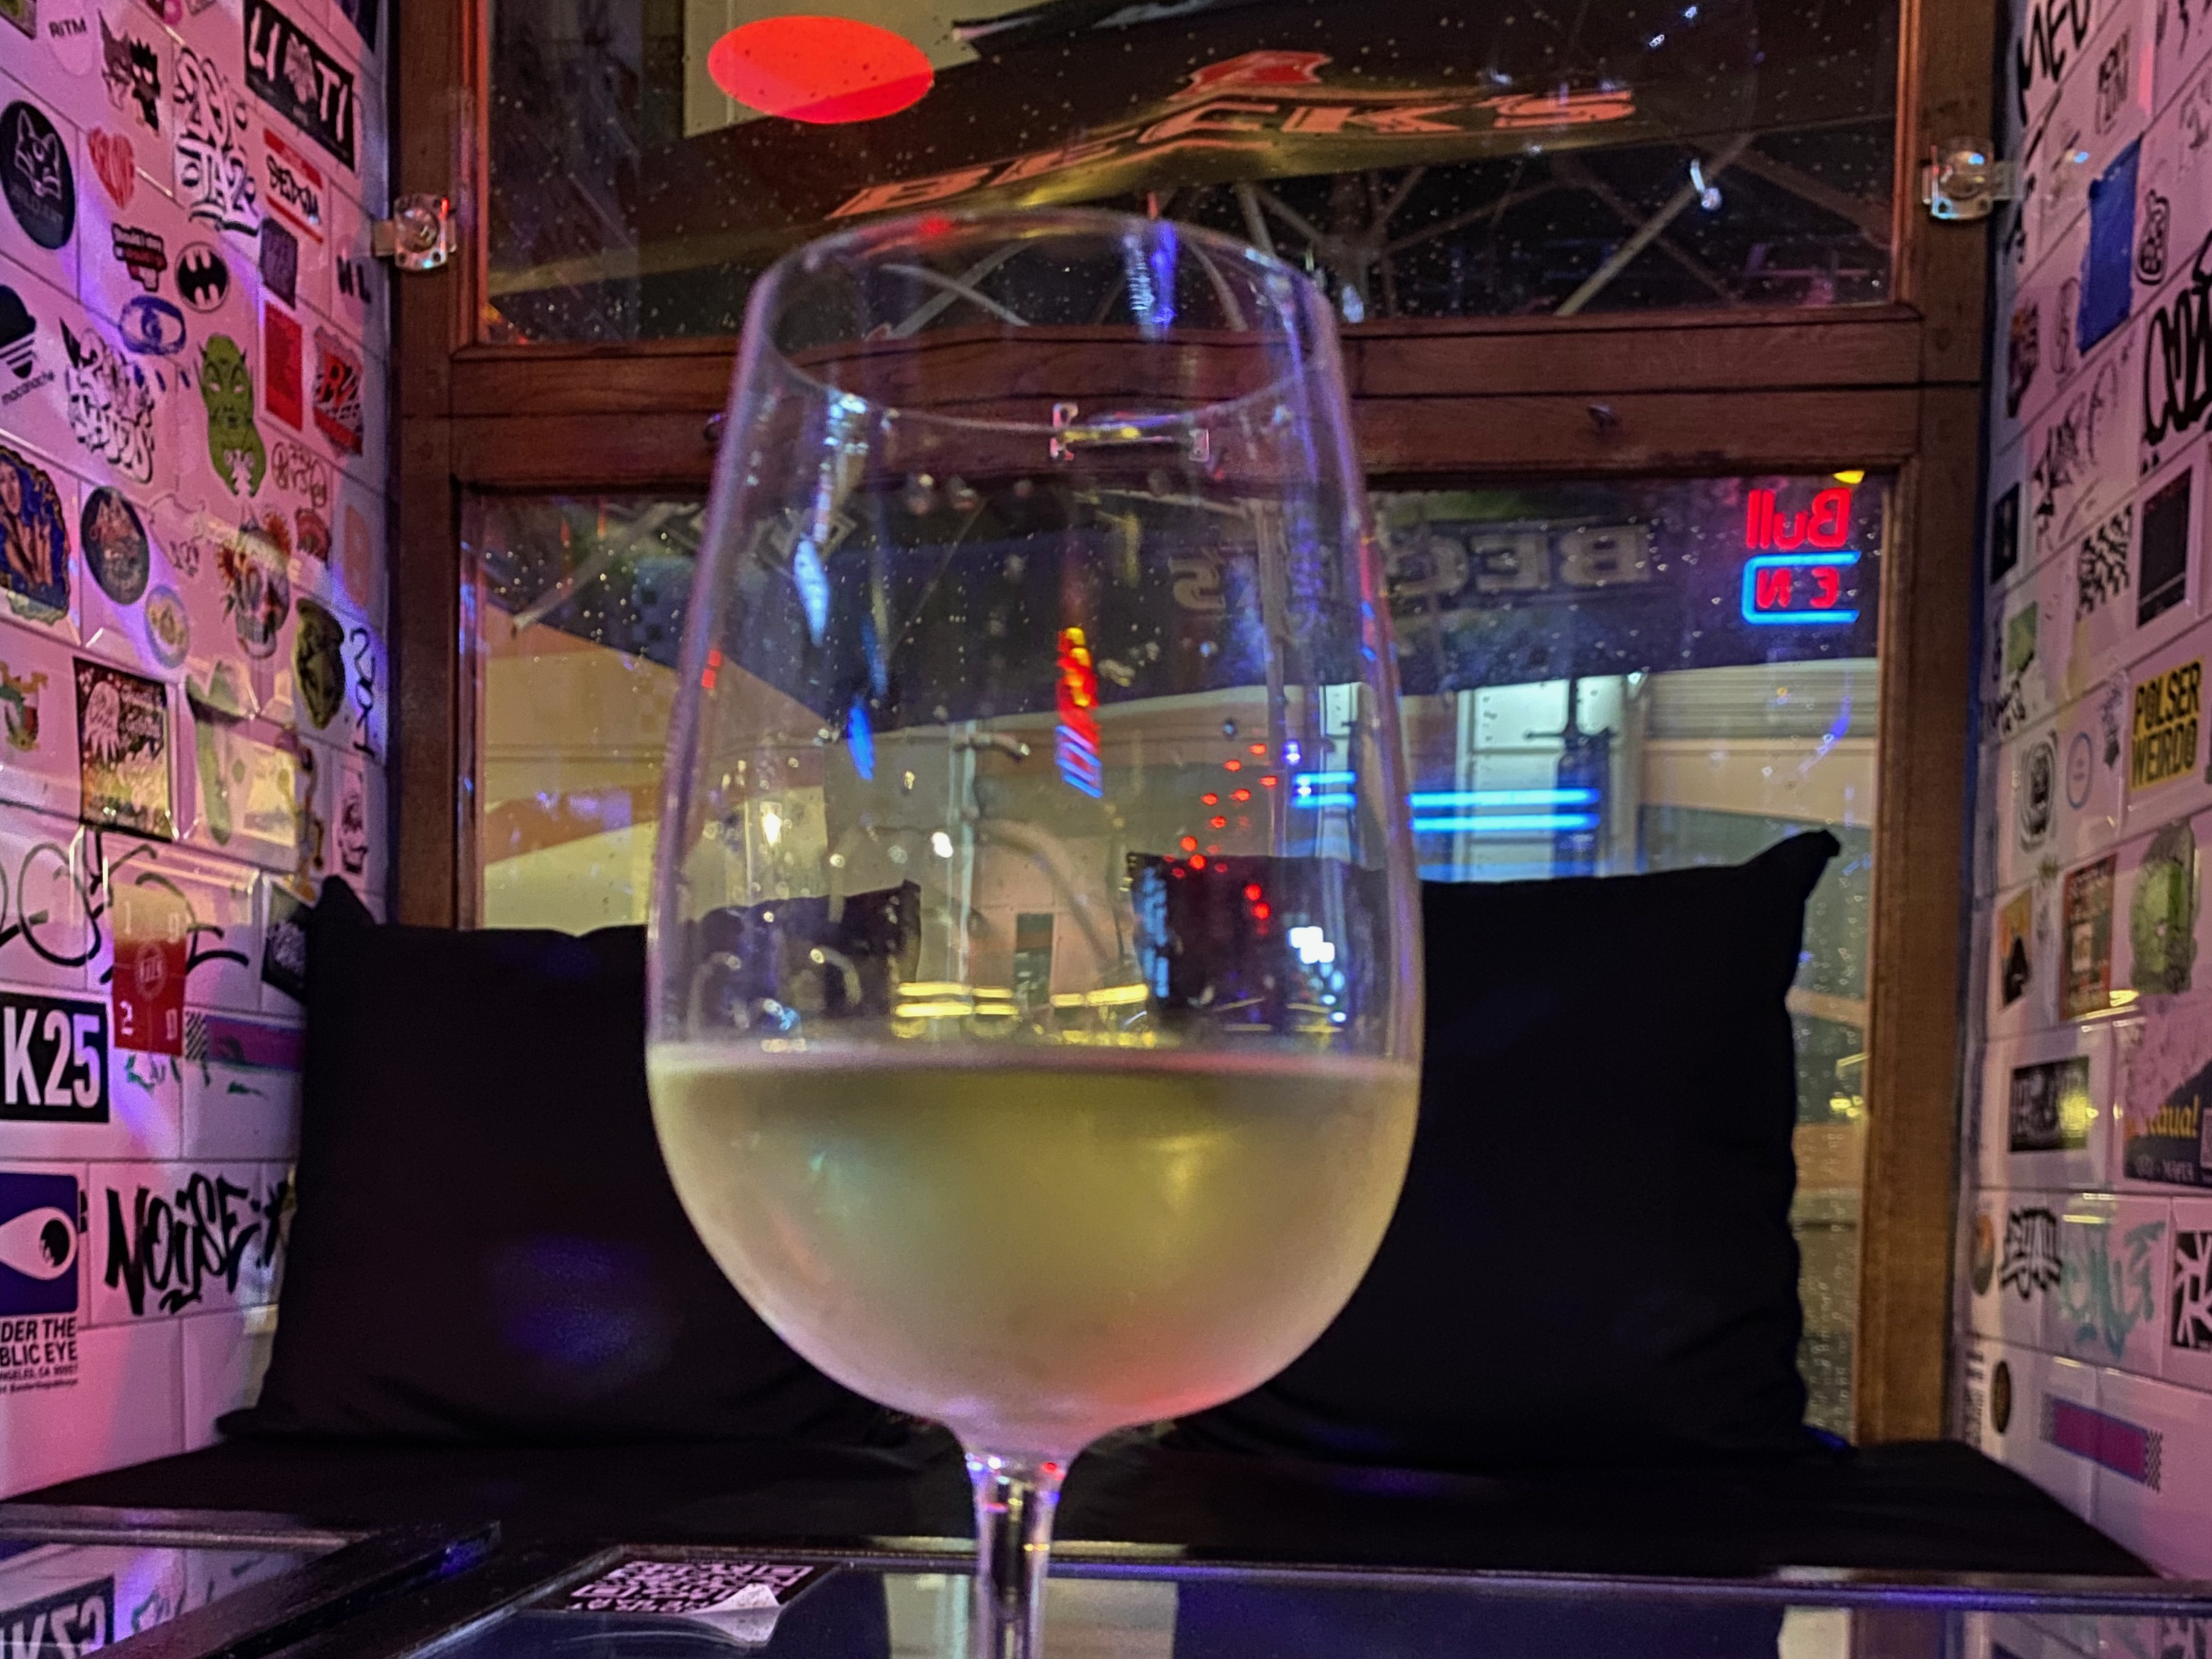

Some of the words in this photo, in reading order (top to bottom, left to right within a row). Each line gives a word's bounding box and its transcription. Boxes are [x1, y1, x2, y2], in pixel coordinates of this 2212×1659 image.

[3, 1006, 101, 1109] K25
[1, 1320, 37, 1342] DER
[43, 1317, 76, 1338] THE
[0, 1344, 40, 1366] BLIC
[45, 1342, 77, 1362] EYE
